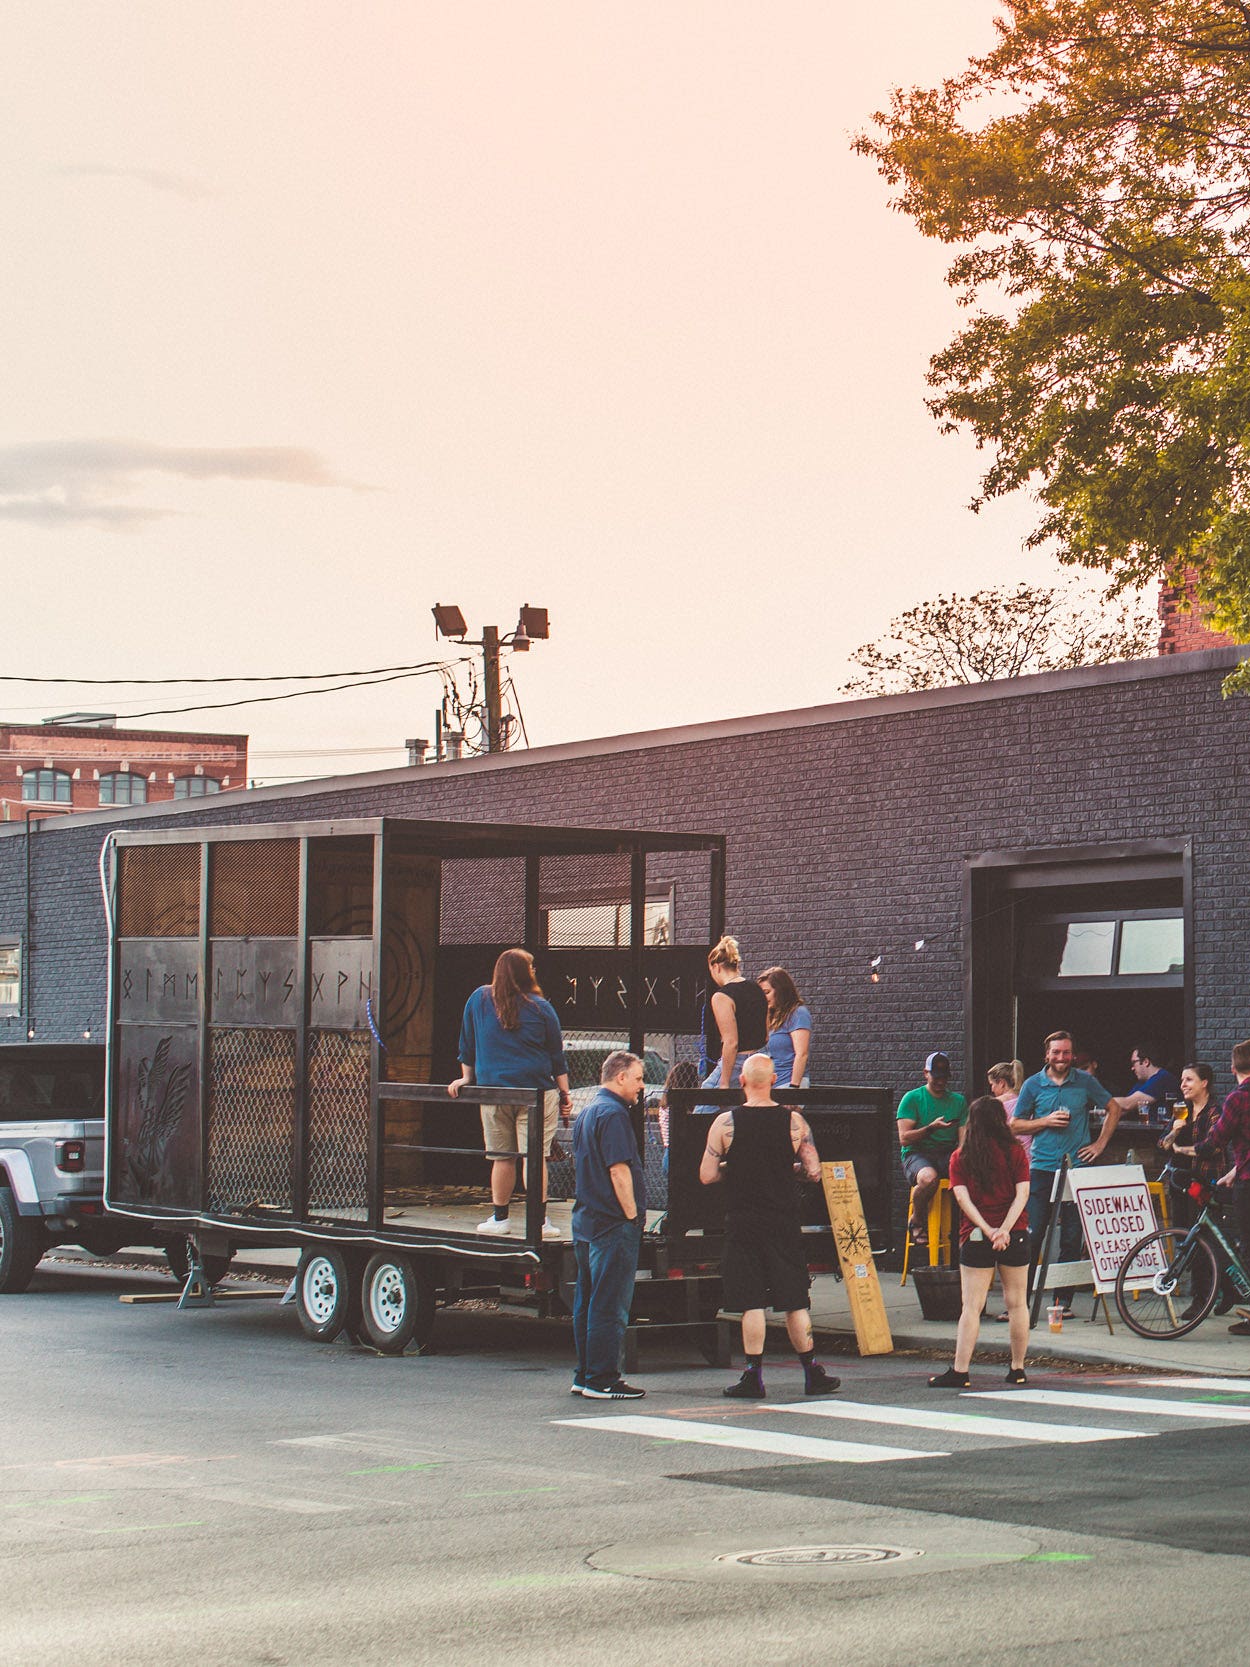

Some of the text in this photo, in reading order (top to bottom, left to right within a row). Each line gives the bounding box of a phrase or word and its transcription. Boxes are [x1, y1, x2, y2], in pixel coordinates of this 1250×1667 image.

[1084, 1194, 1148, 1216] SIDEWALK
[1095, 1215, 1145, 1235] CLOSED
[1094, 1238, 1133, 1255] PLEASE
[1100, 1252, 1160, 1272] OTHE SIDE
